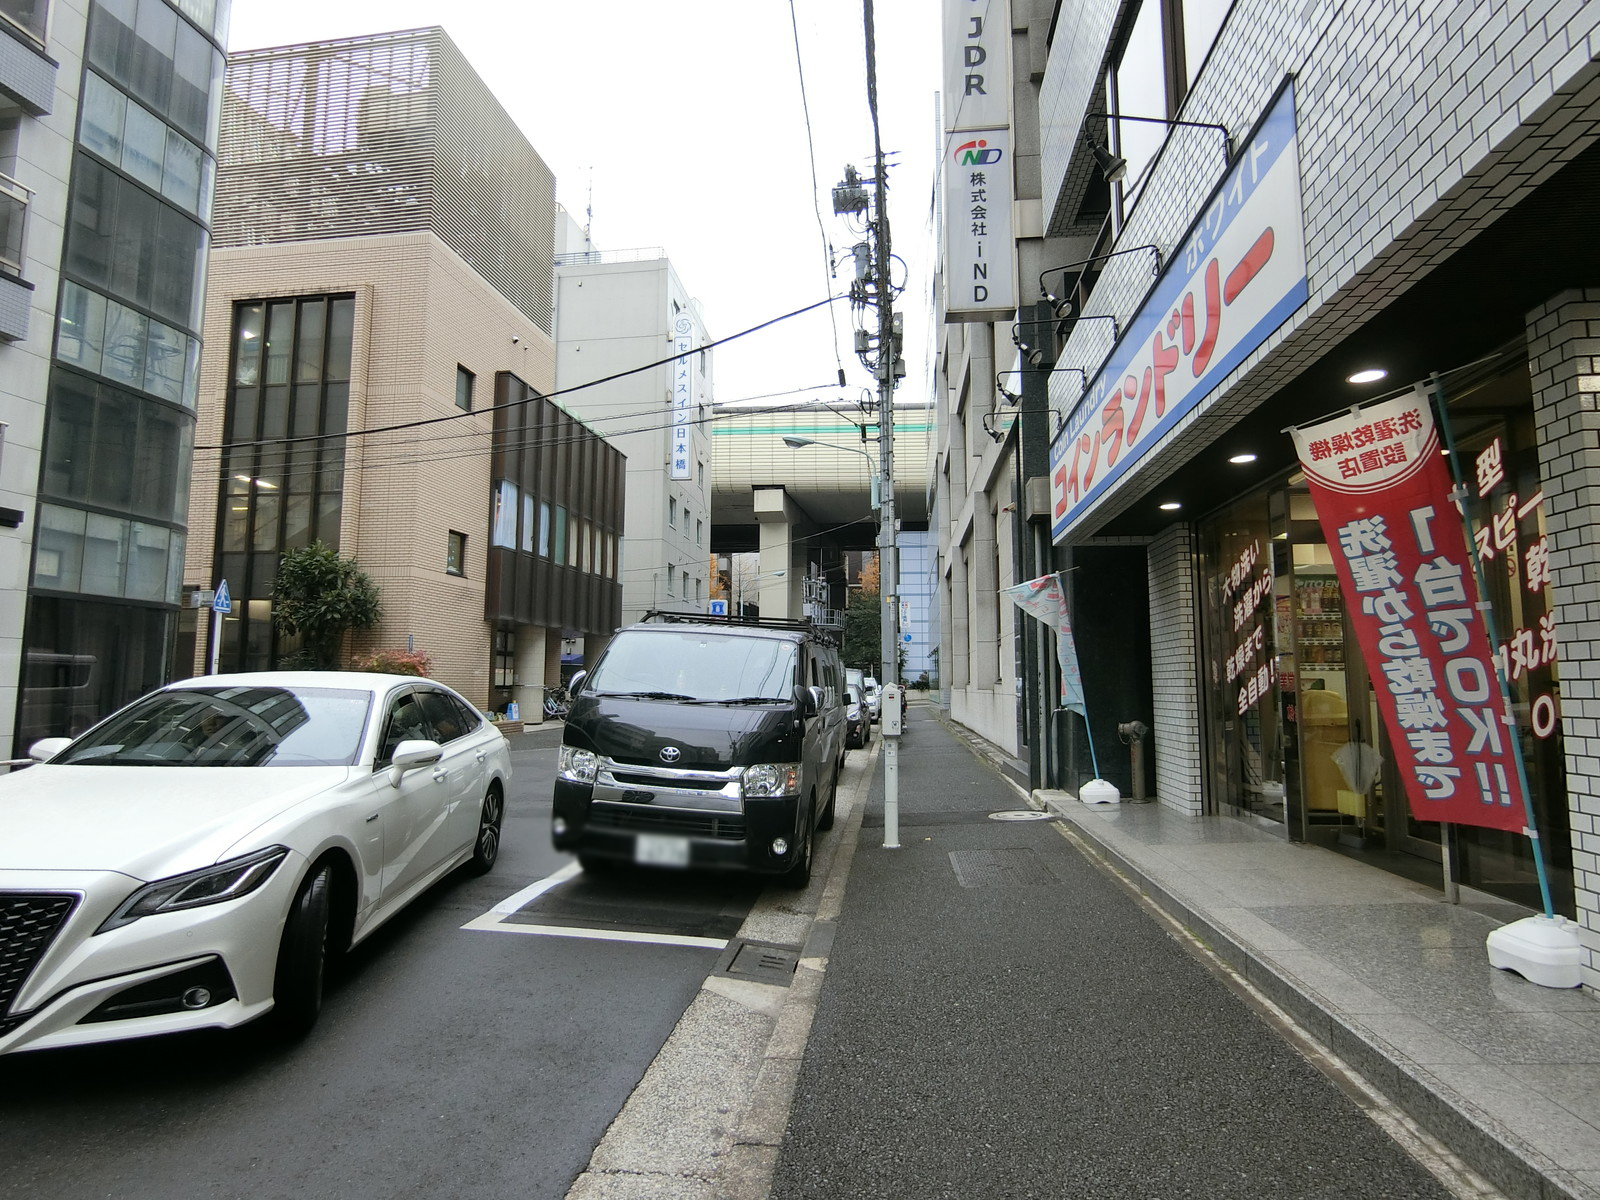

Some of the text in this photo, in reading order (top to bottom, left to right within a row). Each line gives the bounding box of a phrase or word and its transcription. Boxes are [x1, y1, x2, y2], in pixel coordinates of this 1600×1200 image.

[970, 172, 989, 303] 株式会社iND
[1186, 140, 1269, 274] ホワイト
[675, 341, 688, 470] セルメスイン日本橋
[1055, 226, 1275, 520] コインランドリー
[1054, 374, 1107, 461] Coin Laundry
[1221, 538, 1260, 605] 大物洗い
[1233, 567, 1273, 633] 洗濯から
[1304, 580, 1324, 589] ITO
[1226, 624, 1264, 684] 乾燥まで
